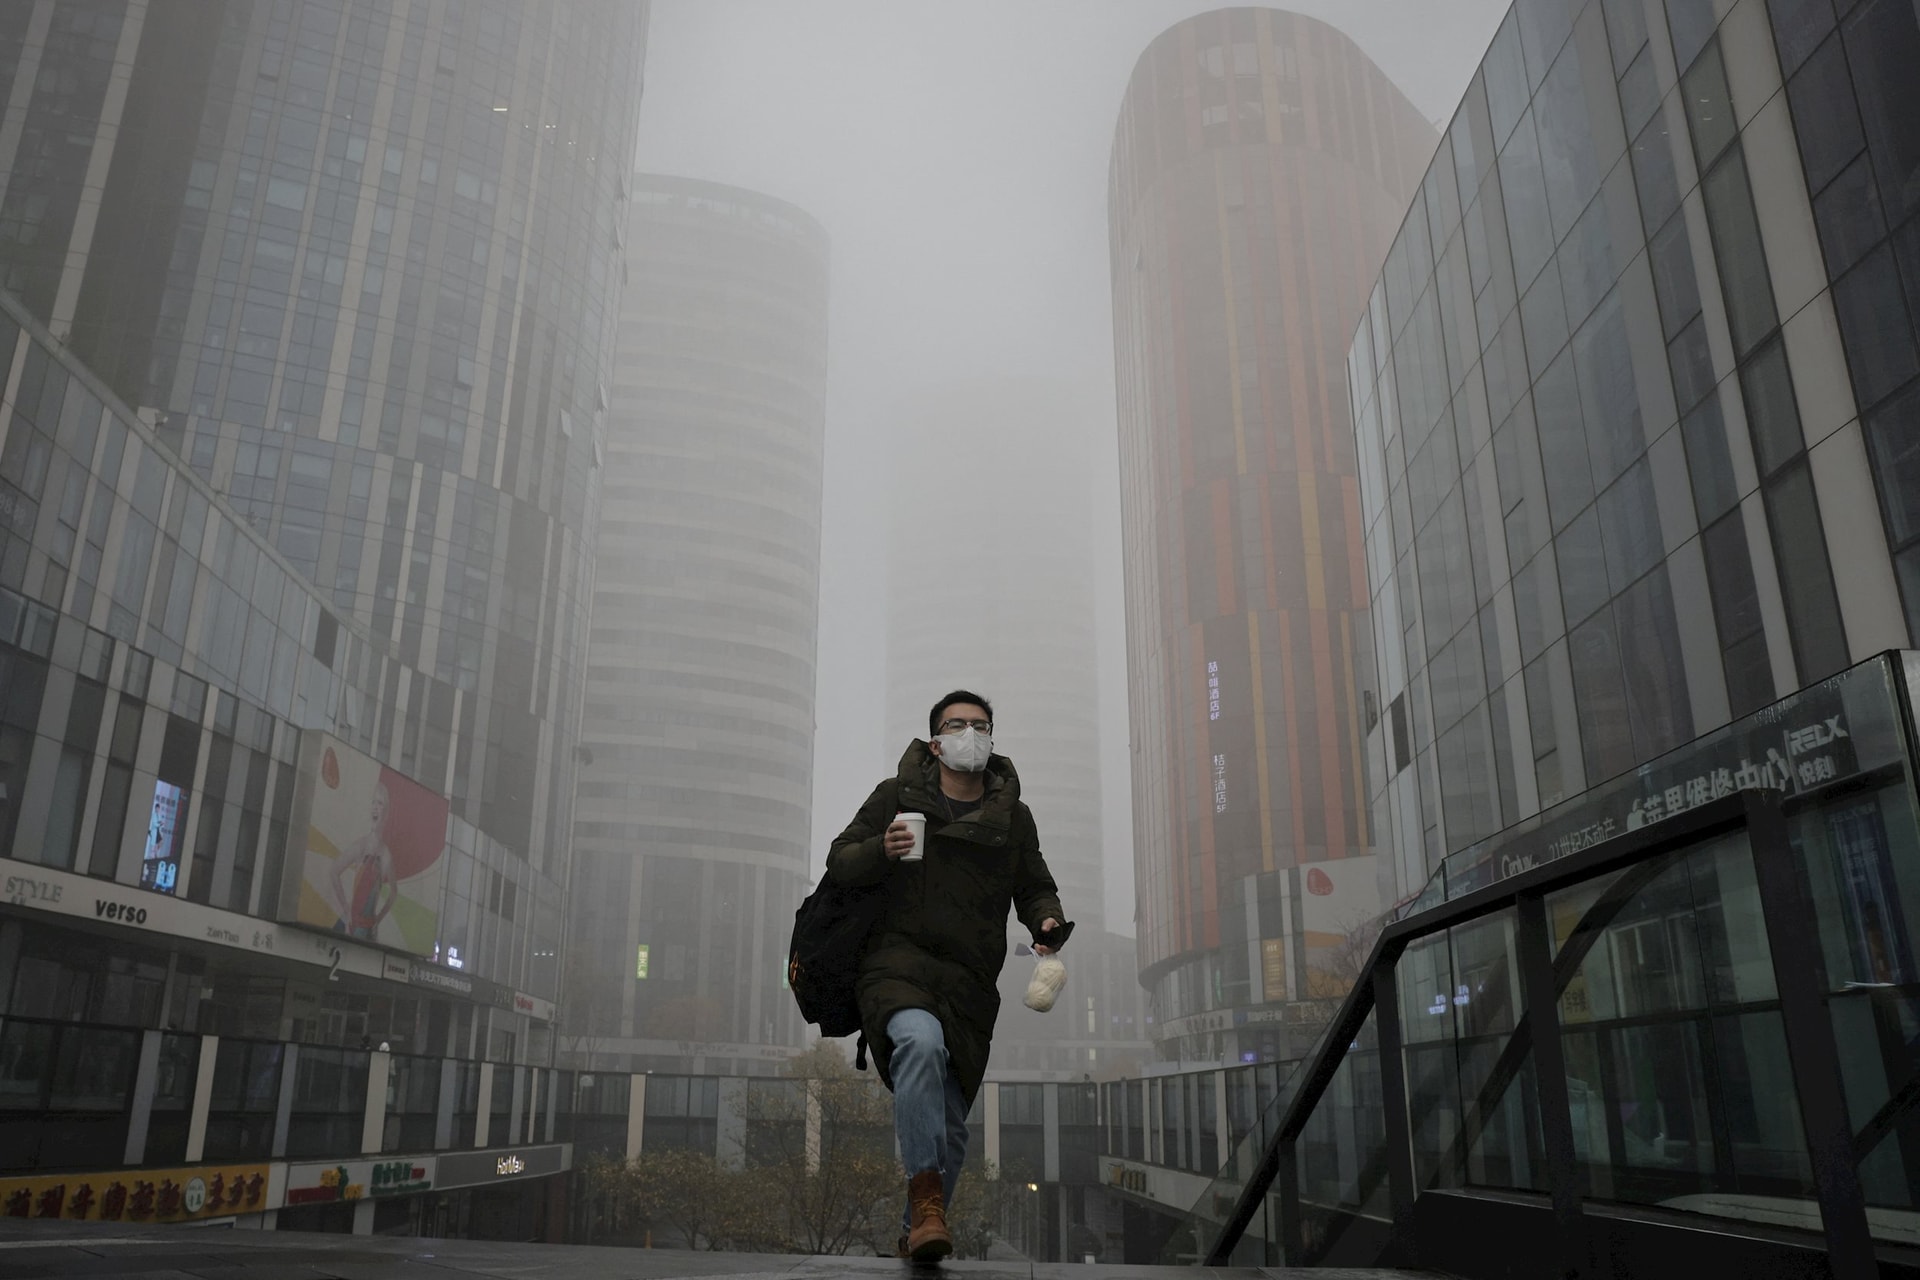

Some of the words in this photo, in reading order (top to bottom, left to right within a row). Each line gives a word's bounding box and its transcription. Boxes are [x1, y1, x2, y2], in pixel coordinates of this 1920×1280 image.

[1789, 714, 1848, 756] RELX
[1214, 754, 1226, 803] 桔子酒店
[1799, 755, 1837, 786] 悦刻
[6, 876, 63, 902] STYLE
[96, 900, 147, 924] verso
[329, 947, 341, 981] 2
